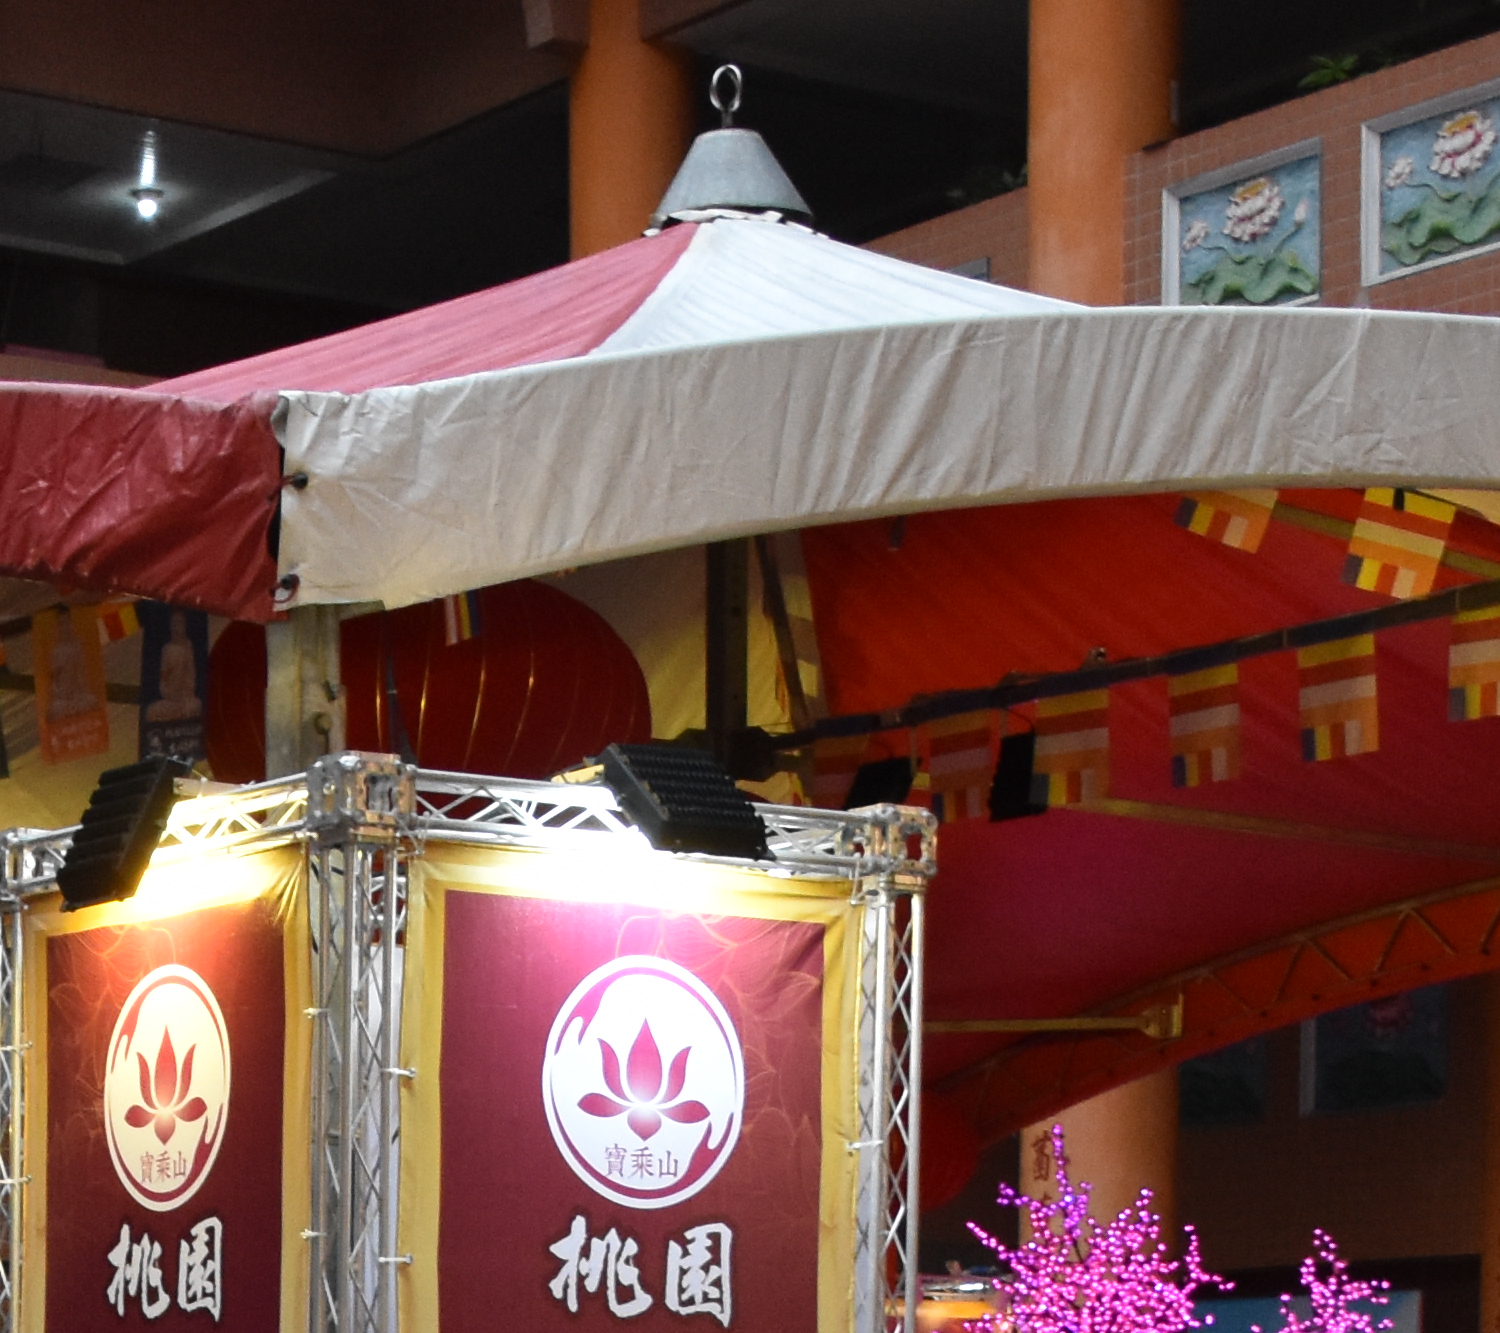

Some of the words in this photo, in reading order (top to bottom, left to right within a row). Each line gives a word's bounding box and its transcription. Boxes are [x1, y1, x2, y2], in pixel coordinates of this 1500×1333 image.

[140, 1152, 188, 1183] 寶乘山
[604, 1144, 680, 1181] 寶乘山
[106, 1216, 224, 1322] 桃園
[549, 1216, 732, 1328] 桃園
